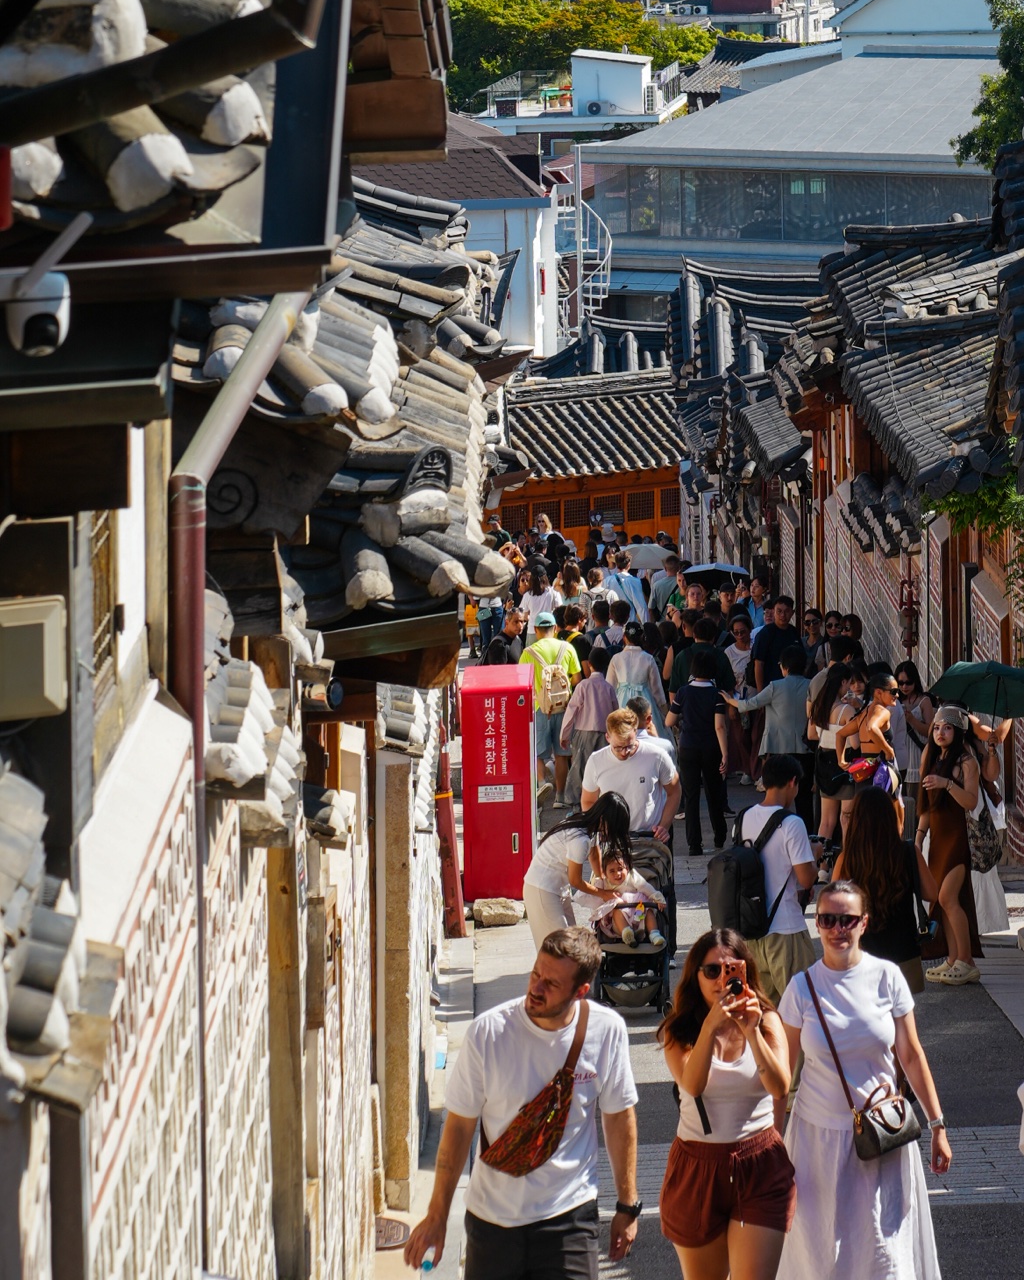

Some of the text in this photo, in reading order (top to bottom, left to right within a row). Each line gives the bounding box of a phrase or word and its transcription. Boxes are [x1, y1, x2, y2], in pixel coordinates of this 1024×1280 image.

[500, 696, 508, 734] Emergency
[484, 697, 496, 776] 비상소화장치
[500, 748, 508, 775] Hydrant
